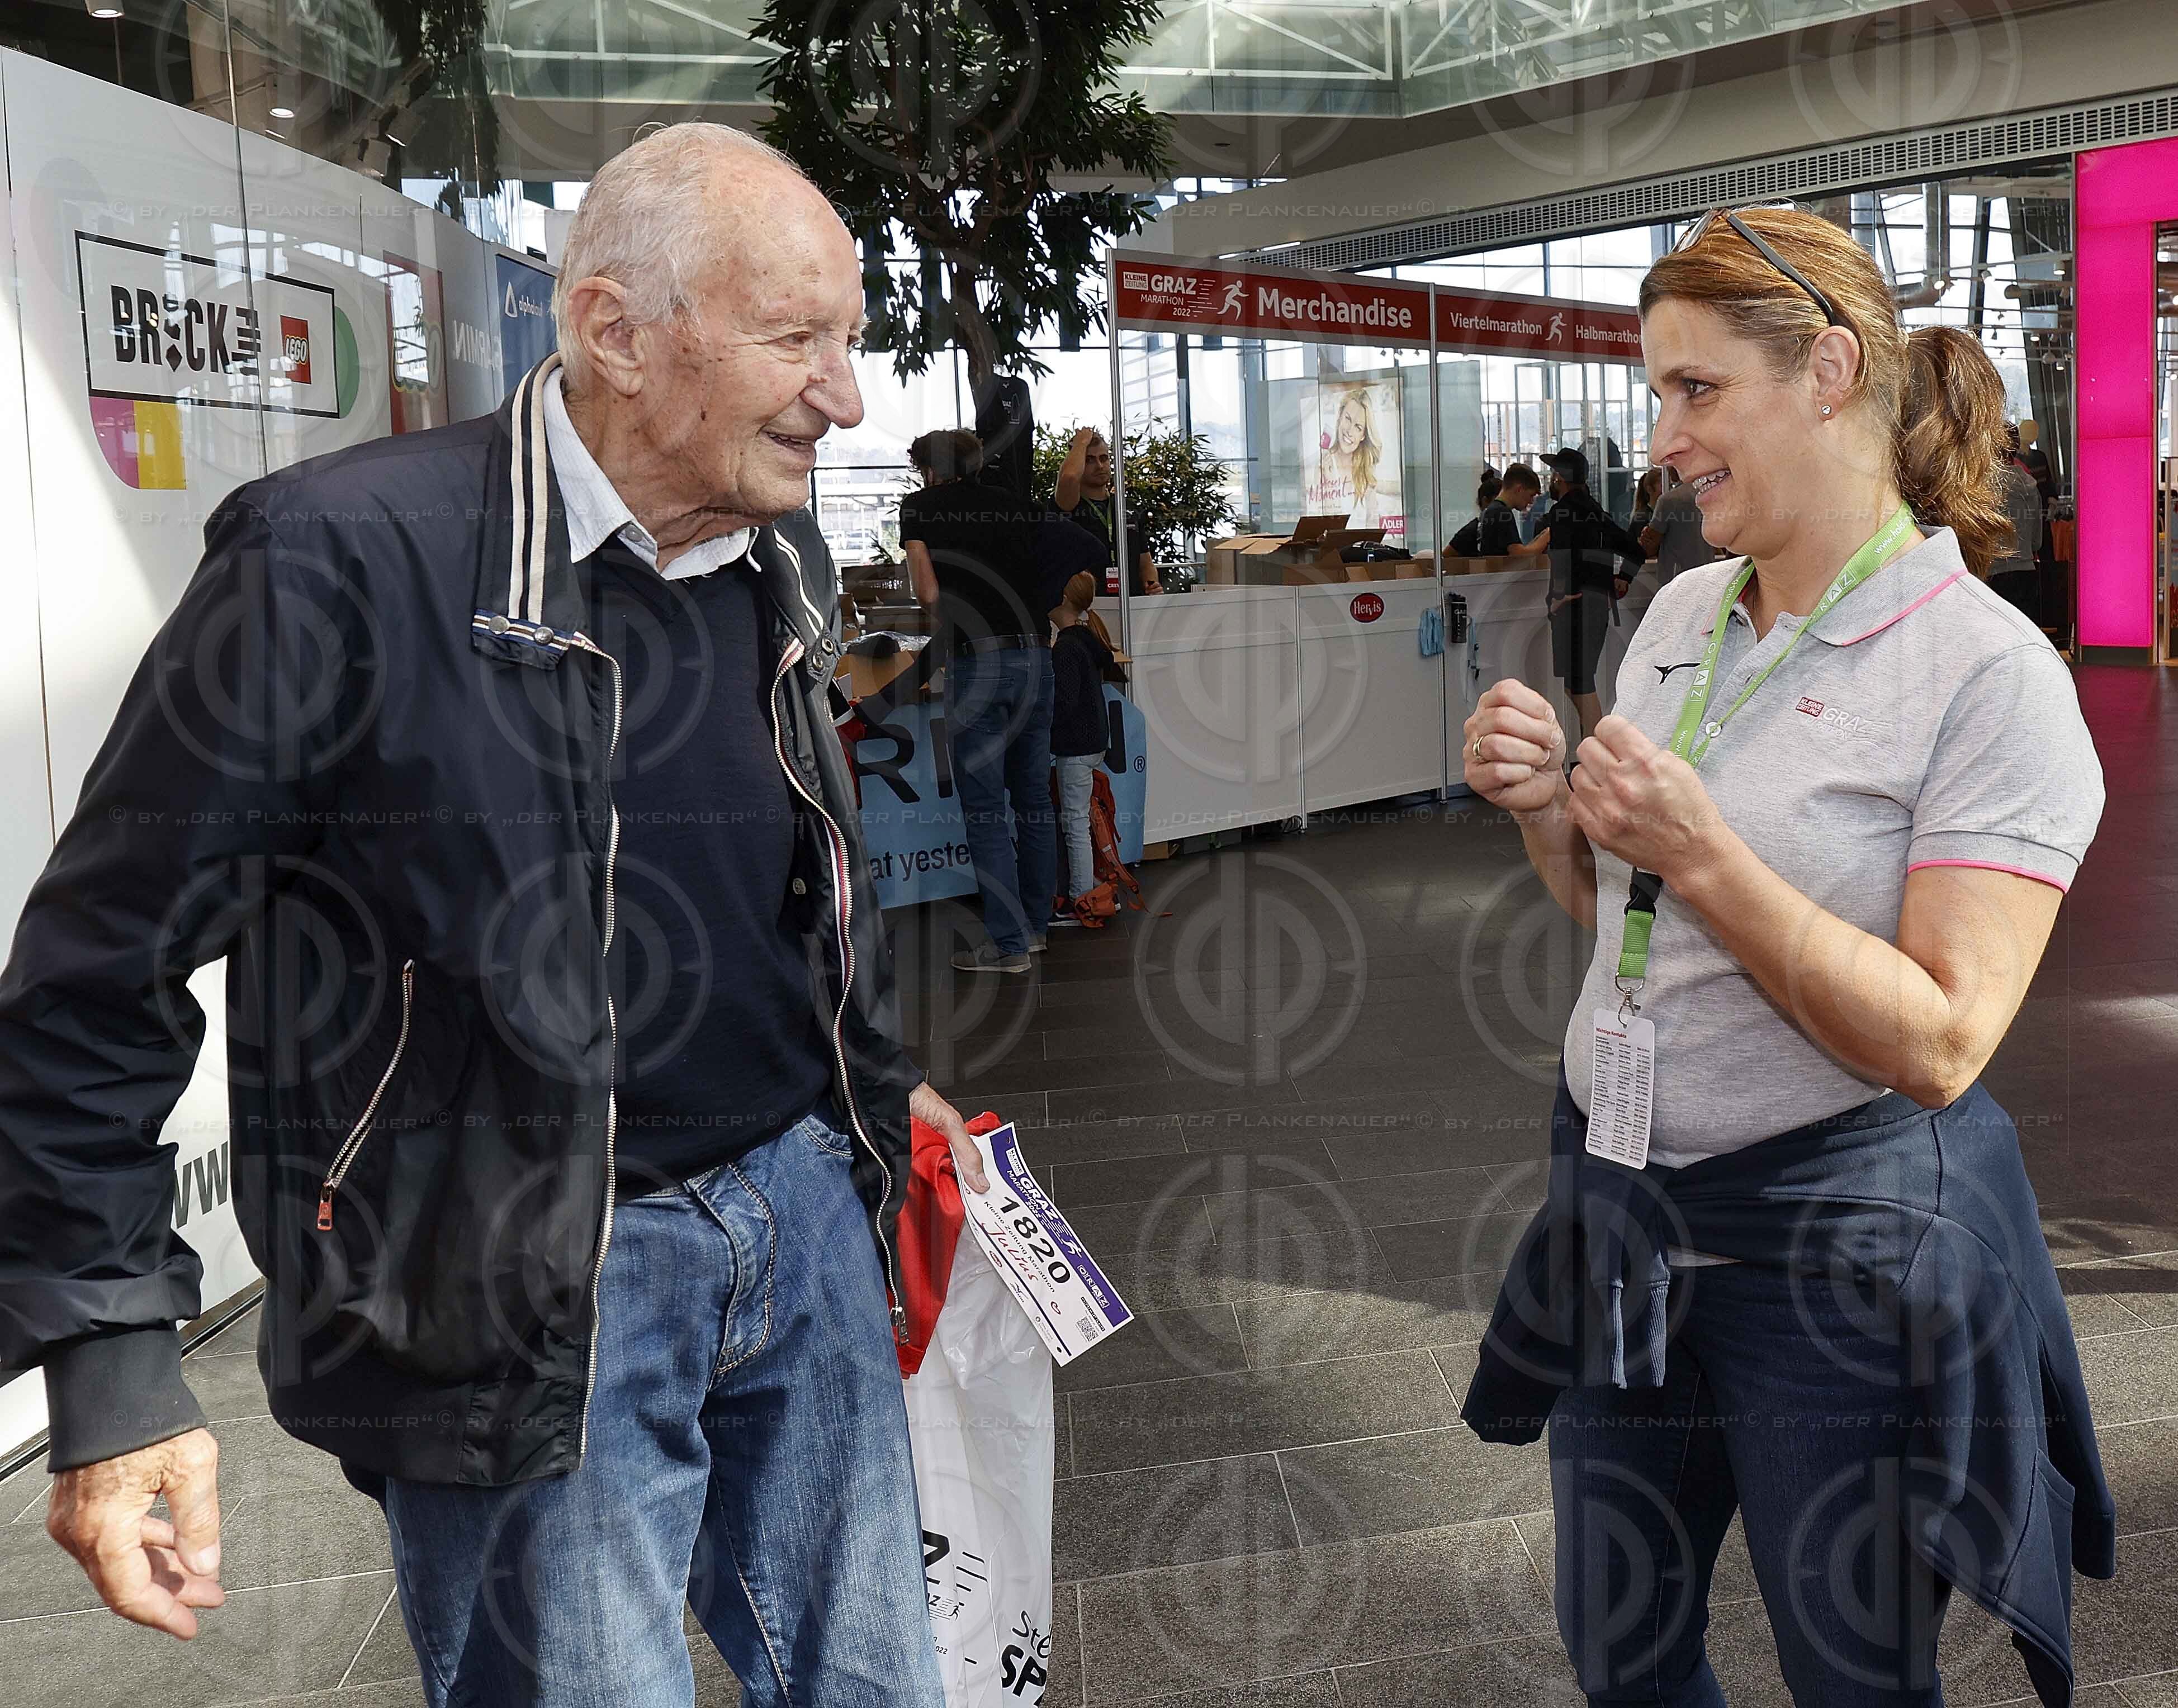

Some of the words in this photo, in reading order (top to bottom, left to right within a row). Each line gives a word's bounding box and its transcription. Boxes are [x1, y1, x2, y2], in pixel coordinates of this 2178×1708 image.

[1150, 274, 1197, 295] GRAZ
[1140, 294, 1184, 305] MARATHON
[1173, 307, 1190, 317] 2022
[1258, 287, 1412, 329] Merchandise
[1450, 311, 1543, 335] Viertelmarathon
[286, 335, 309, 364] LEGO
[1381, 518, 1404, 530] ADLER
[1353, 601, 1382, 615] Hervis
[1796, 703, 1819, 716] ZEITUNG
[1800, 698, 1823, 711] KLEINE
[870, 850, 894, 881] at
[899, 841, 970, 881] yeste
[1010, 1149, 1023, 1174] KLEINE
[1007, 1170, 1041, 1211] MARATHON
[1020, 1176, 1059, 1221] GRAZ
[1024, 1201, 1042, 1218] 2022
[984, 1201, 1005, 1225] Kleine
[1005, 1224, 1027, 1255] Zeitung
[1027, 1255, 1055, 1293] Marathon
[1000, 1196, 1071, 1284] 1820
[1078, 1266, 1110, 1307] GRAZ
[1012, 1610, 1052, 1659] Ste
[936, 1645, 948, 1655] 022
[1001, 1644, 1047, 1706] SP
